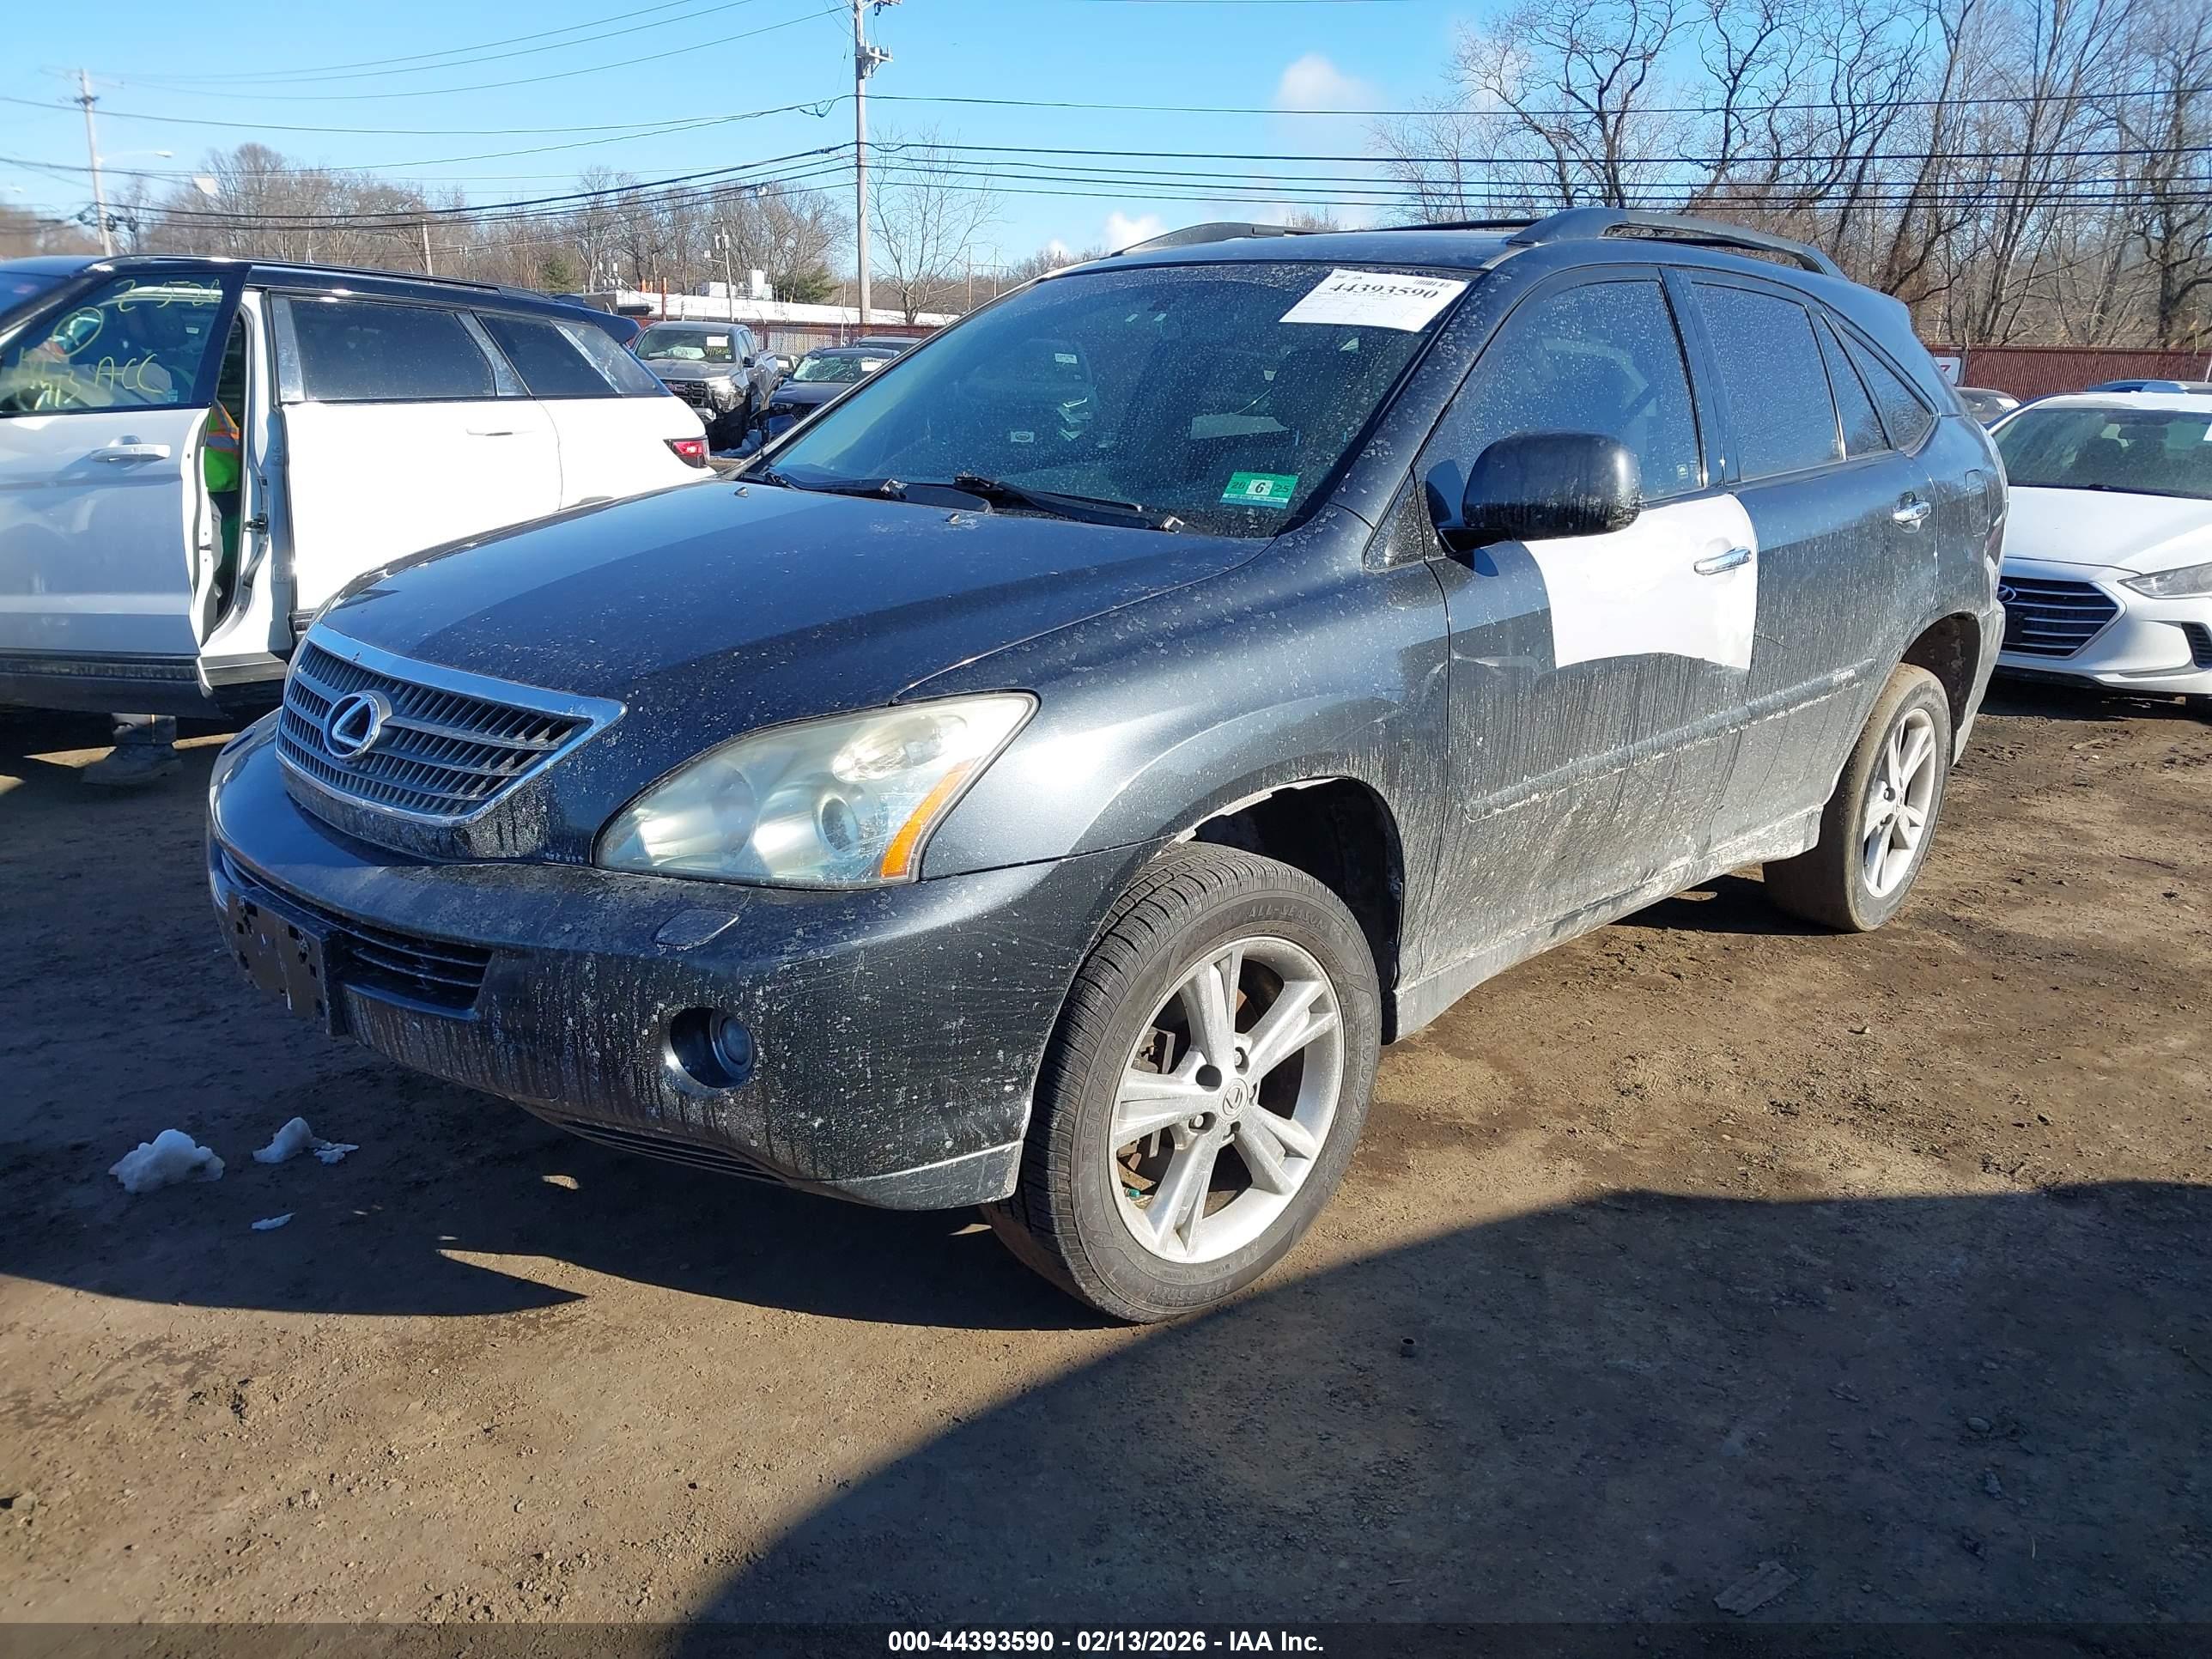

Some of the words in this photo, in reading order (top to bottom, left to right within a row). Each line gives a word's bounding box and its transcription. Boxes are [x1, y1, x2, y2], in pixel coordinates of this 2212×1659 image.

[1329, 283, 1439, 299] 44393590
[1231, 481, 1246, 489] 20
[1255, 482, 1266, 494] 6
[1273, 484, 1291, 493] 25
